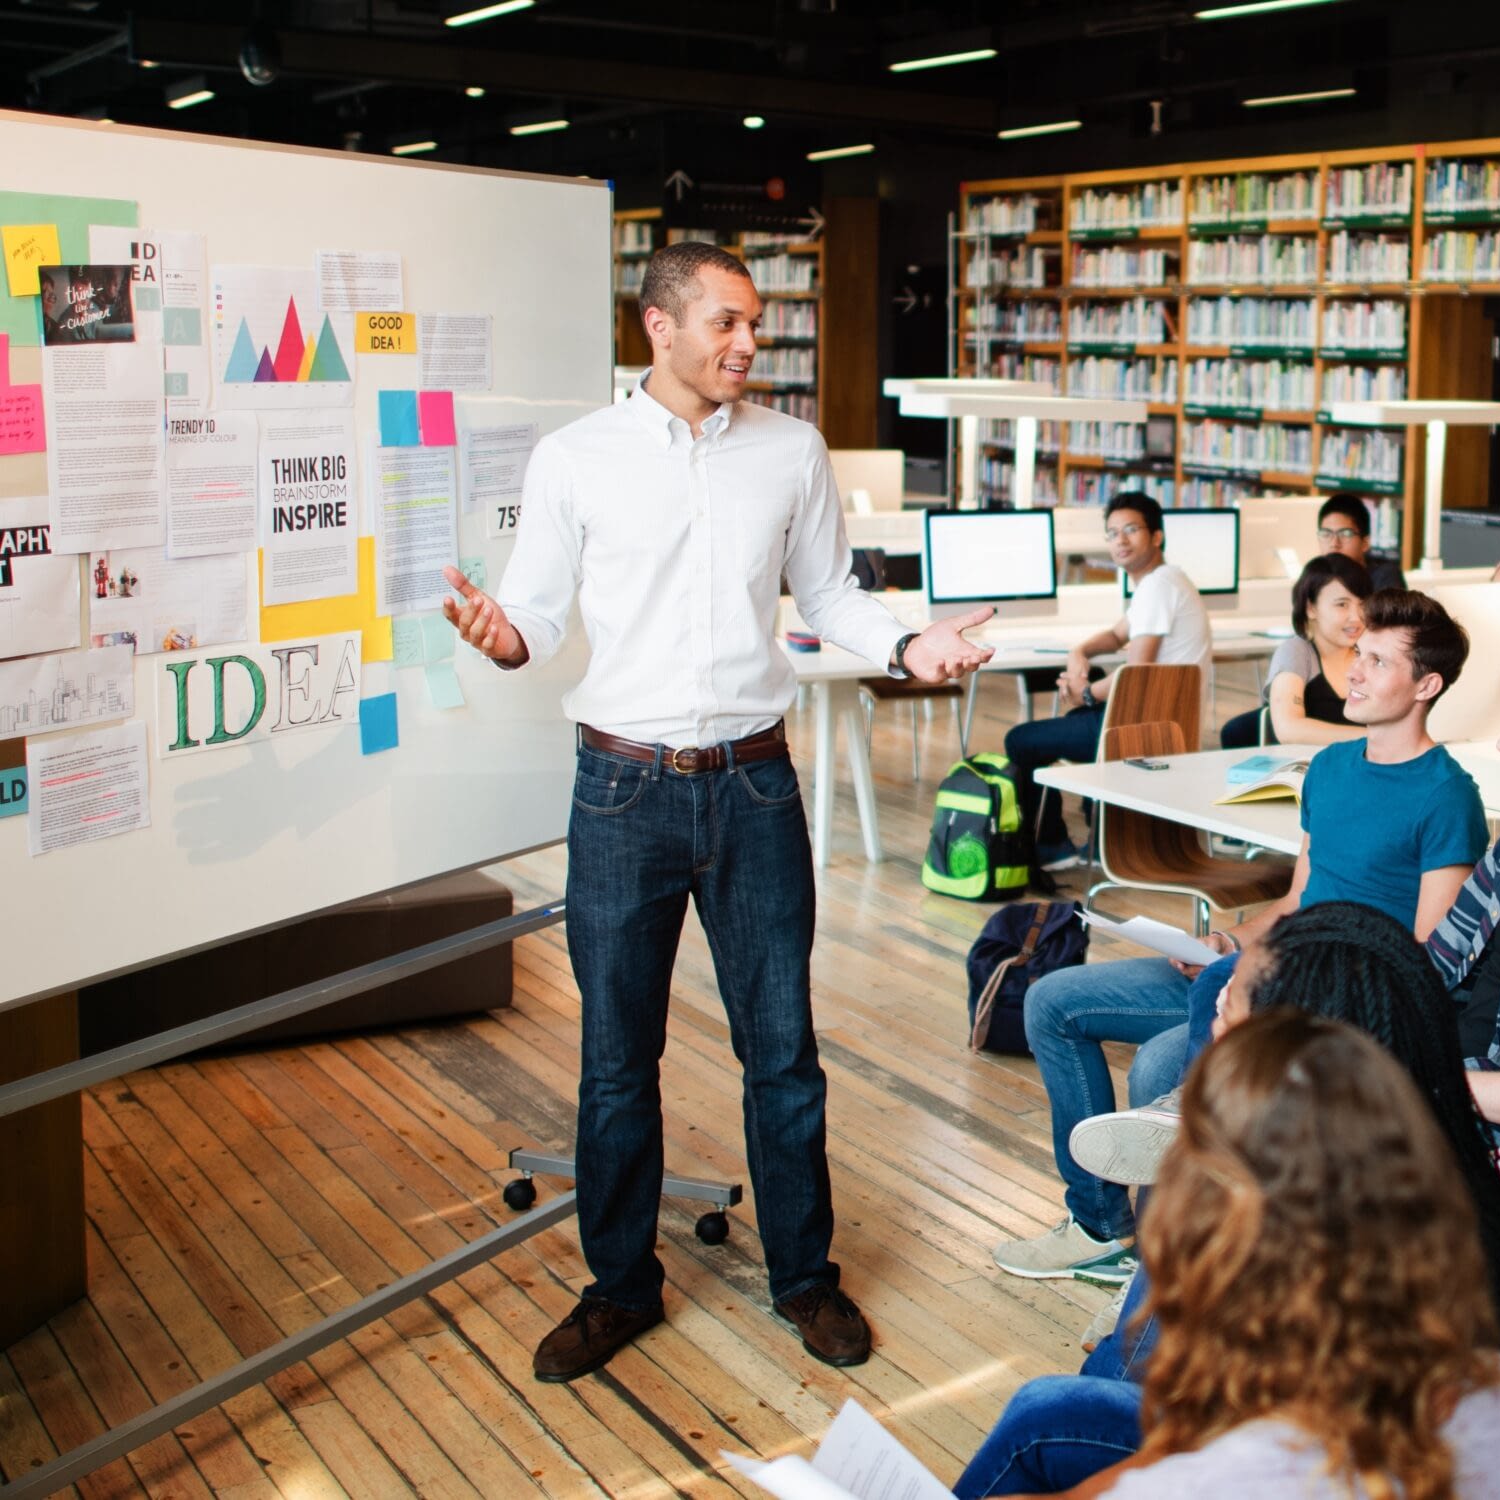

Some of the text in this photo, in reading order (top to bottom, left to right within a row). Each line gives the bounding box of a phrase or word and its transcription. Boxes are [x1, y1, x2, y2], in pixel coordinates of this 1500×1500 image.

[131, 242, 156, 260] ID
[131, 264, 156, 282] EA
[65, 281, 97, 305] think
[368, 316, 403, 330] GOOD
[371, 336, 395, 350] IDEA
[170, 419, 216, 434] TRENDY 10
[272, 455, 346, 485] THINK BIG
[273, 485, 347, 503] BRAINSTORM
[273, 502, 347, 534] INSPIRE
[166, 639, 357, 751] IDEA
